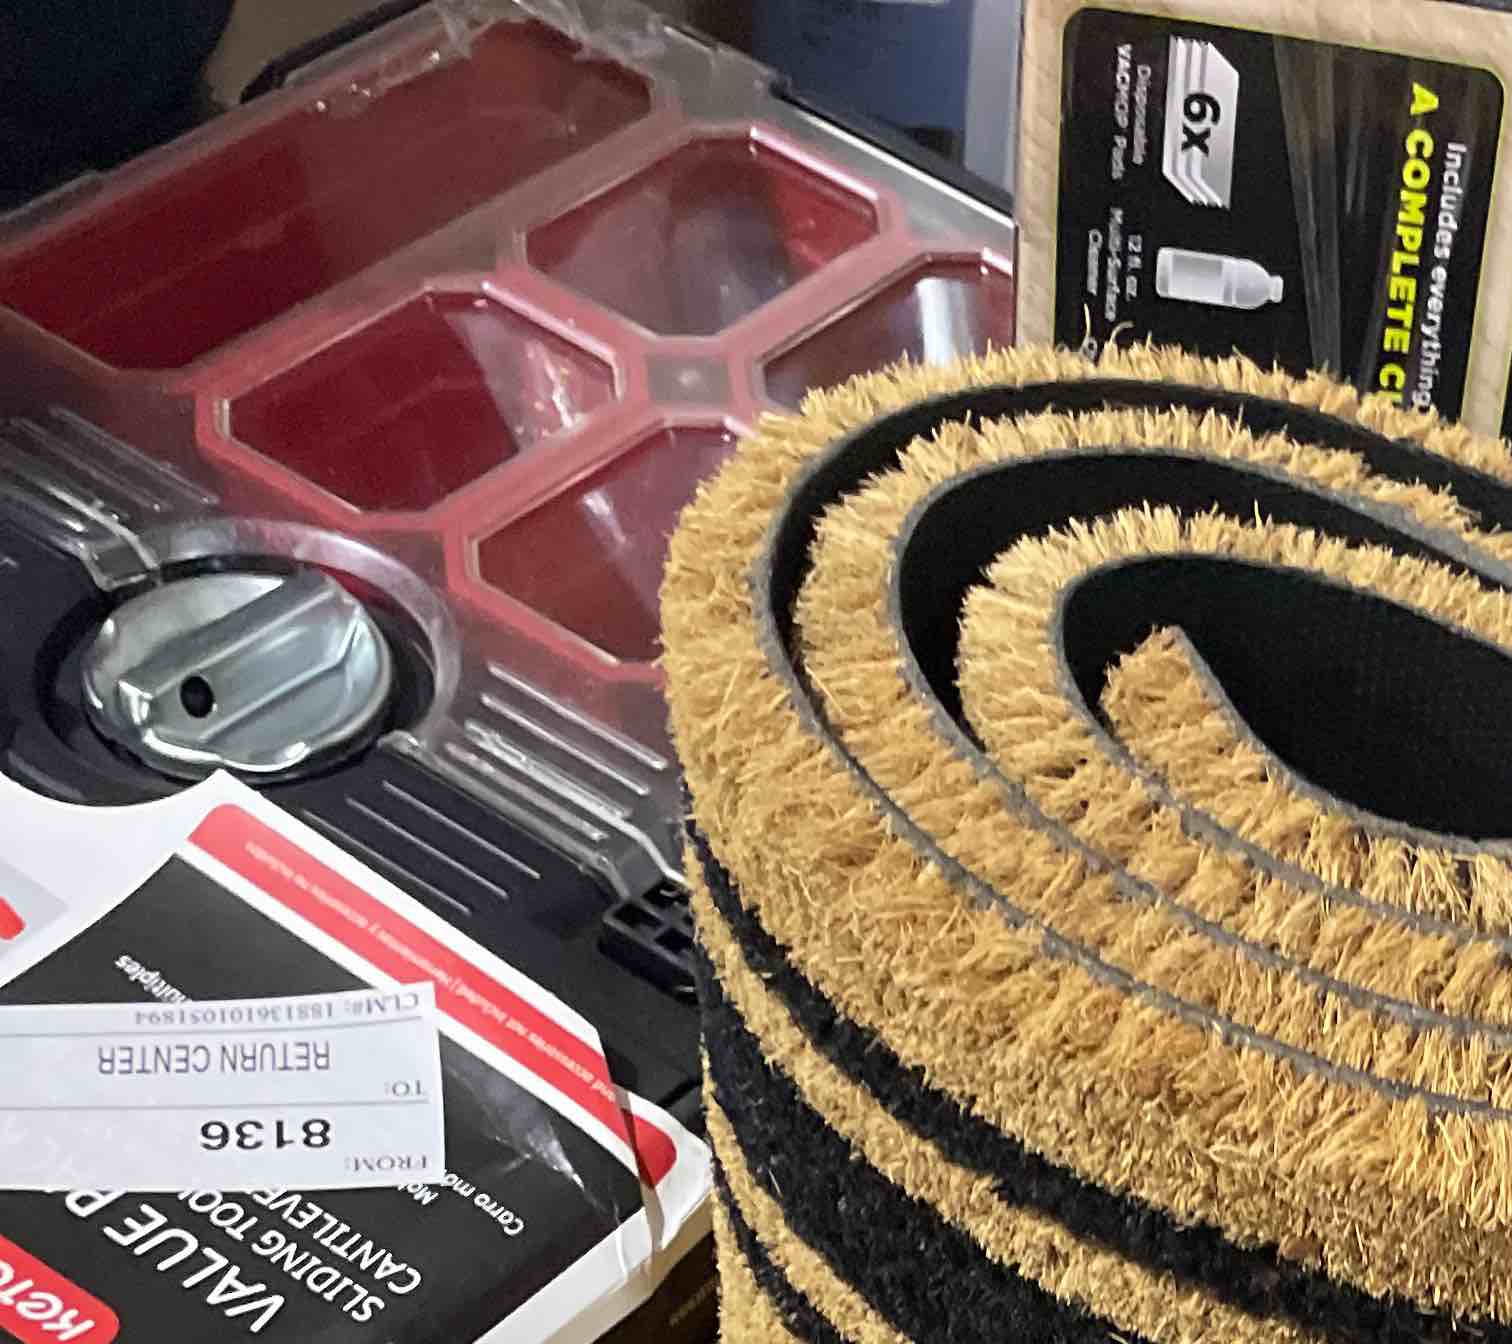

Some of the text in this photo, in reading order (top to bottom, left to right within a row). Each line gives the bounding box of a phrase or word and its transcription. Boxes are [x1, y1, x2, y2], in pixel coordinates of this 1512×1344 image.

[1410, 82, 1439, 115] A
[1434, 142, 1467, 259] Includes
[1384, 128, 1434, 354] COMPLETE
[98, 1042, 330, 1075] RETURN CENTER
[200, 1118, 331, 1151] 8136
[475, 1193, 525, 1237] Carro
[104, 1201, 285, 1333] VALUE
[252, 1231, 385, 1323] SLIDING
